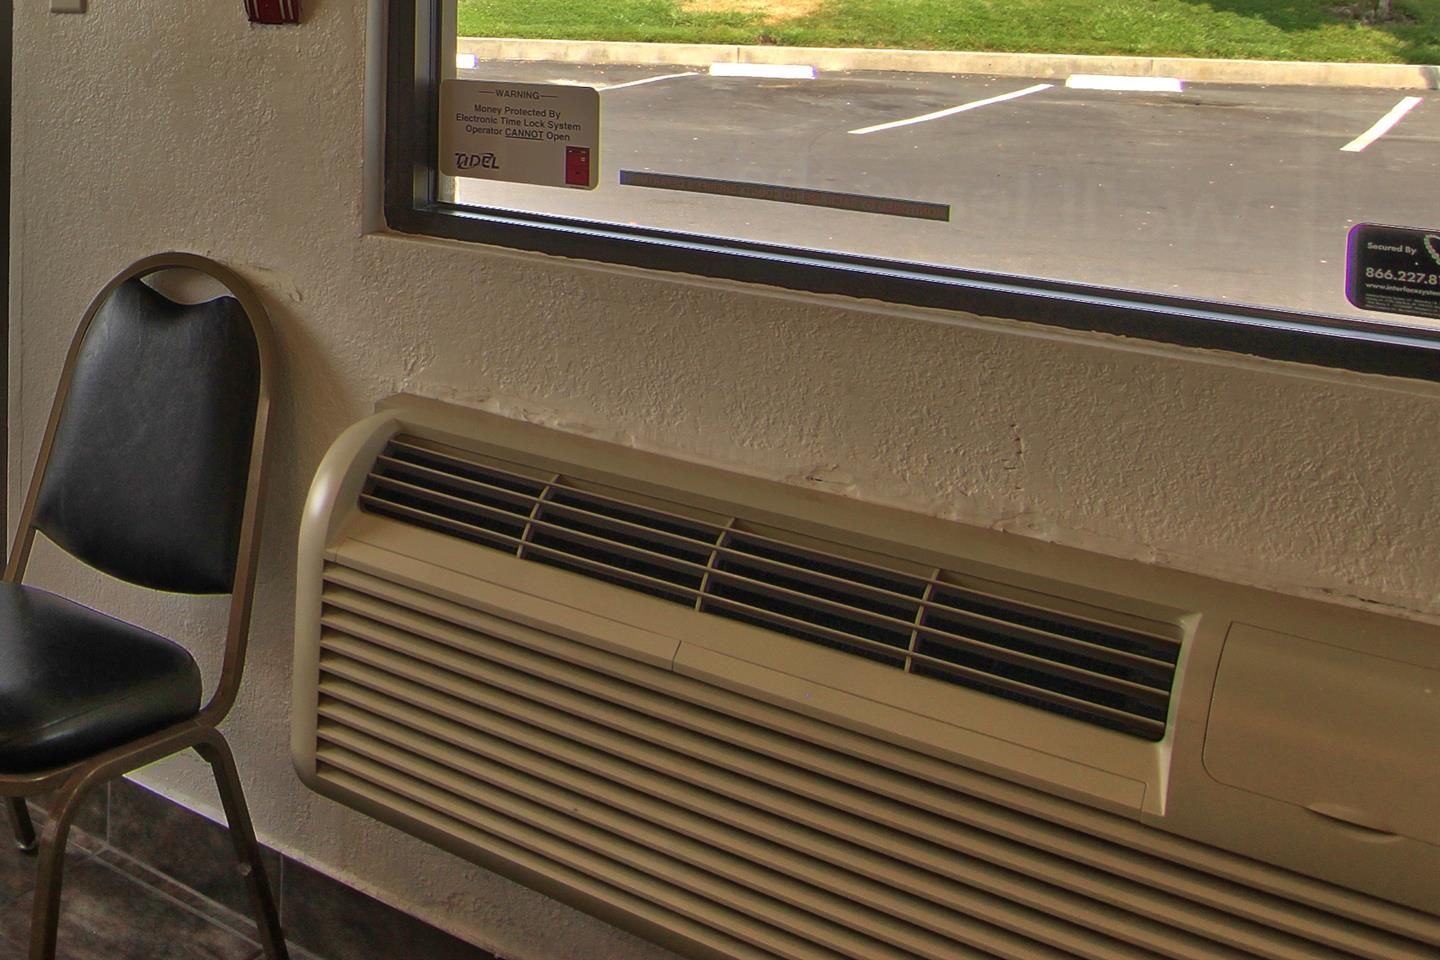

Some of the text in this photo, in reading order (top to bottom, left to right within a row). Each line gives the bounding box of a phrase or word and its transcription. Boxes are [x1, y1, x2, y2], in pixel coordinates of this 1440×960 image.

[496, 90, 540, 100] WARNING
[474, 104, 561, 120] Money Protected By
[456, 113, 581, 131] Electronic Time Lock System
[466, 125, 570, 141] Operator CANNOT Open
[1368, 242, 1416, 255] Secured By
